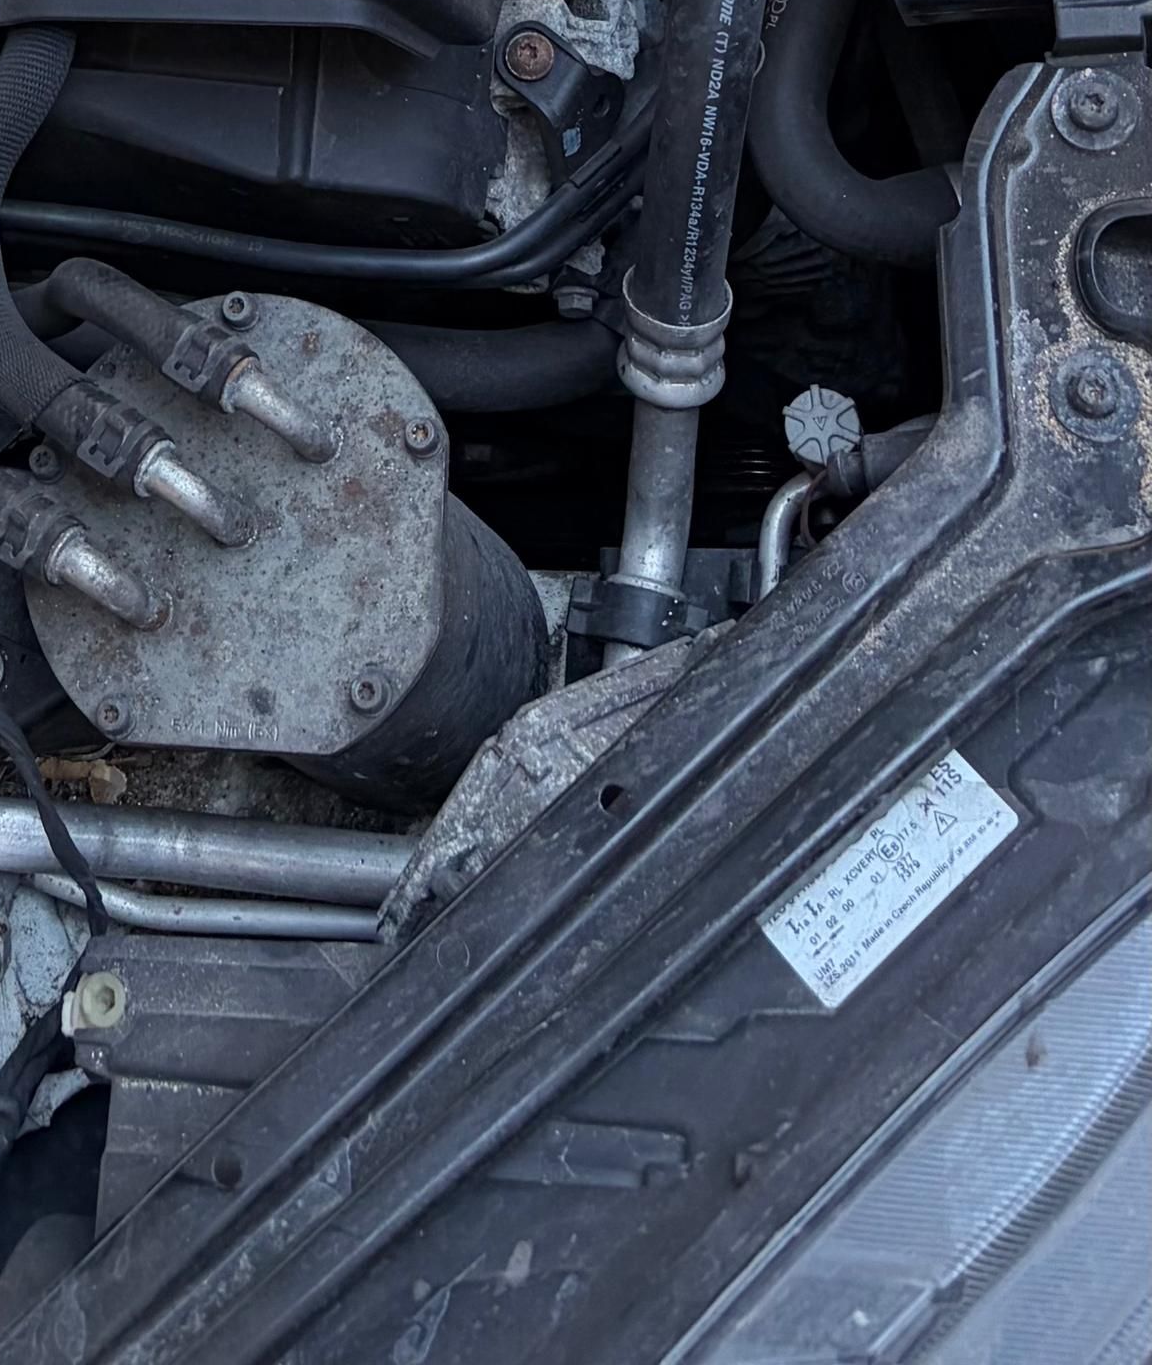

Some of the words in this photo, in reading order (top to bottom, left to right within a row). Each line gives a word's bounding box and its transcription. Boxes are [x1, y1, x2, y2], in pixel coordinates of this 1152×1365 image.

[715, 31, 729, 54] (T)
[708, 58, 725, 100] ND2A
[870, 826, 885, 840] PL
[809, 932, 822, 946] 01
[826, 916, 839, 929] 02
[842, 899, 856, 912] 00
[862, 928, 884, 950] Made
[883, 917, 893, 928] in
[892, 895, 916, 920] Czech
[814, 959, 836, 982] UM7
